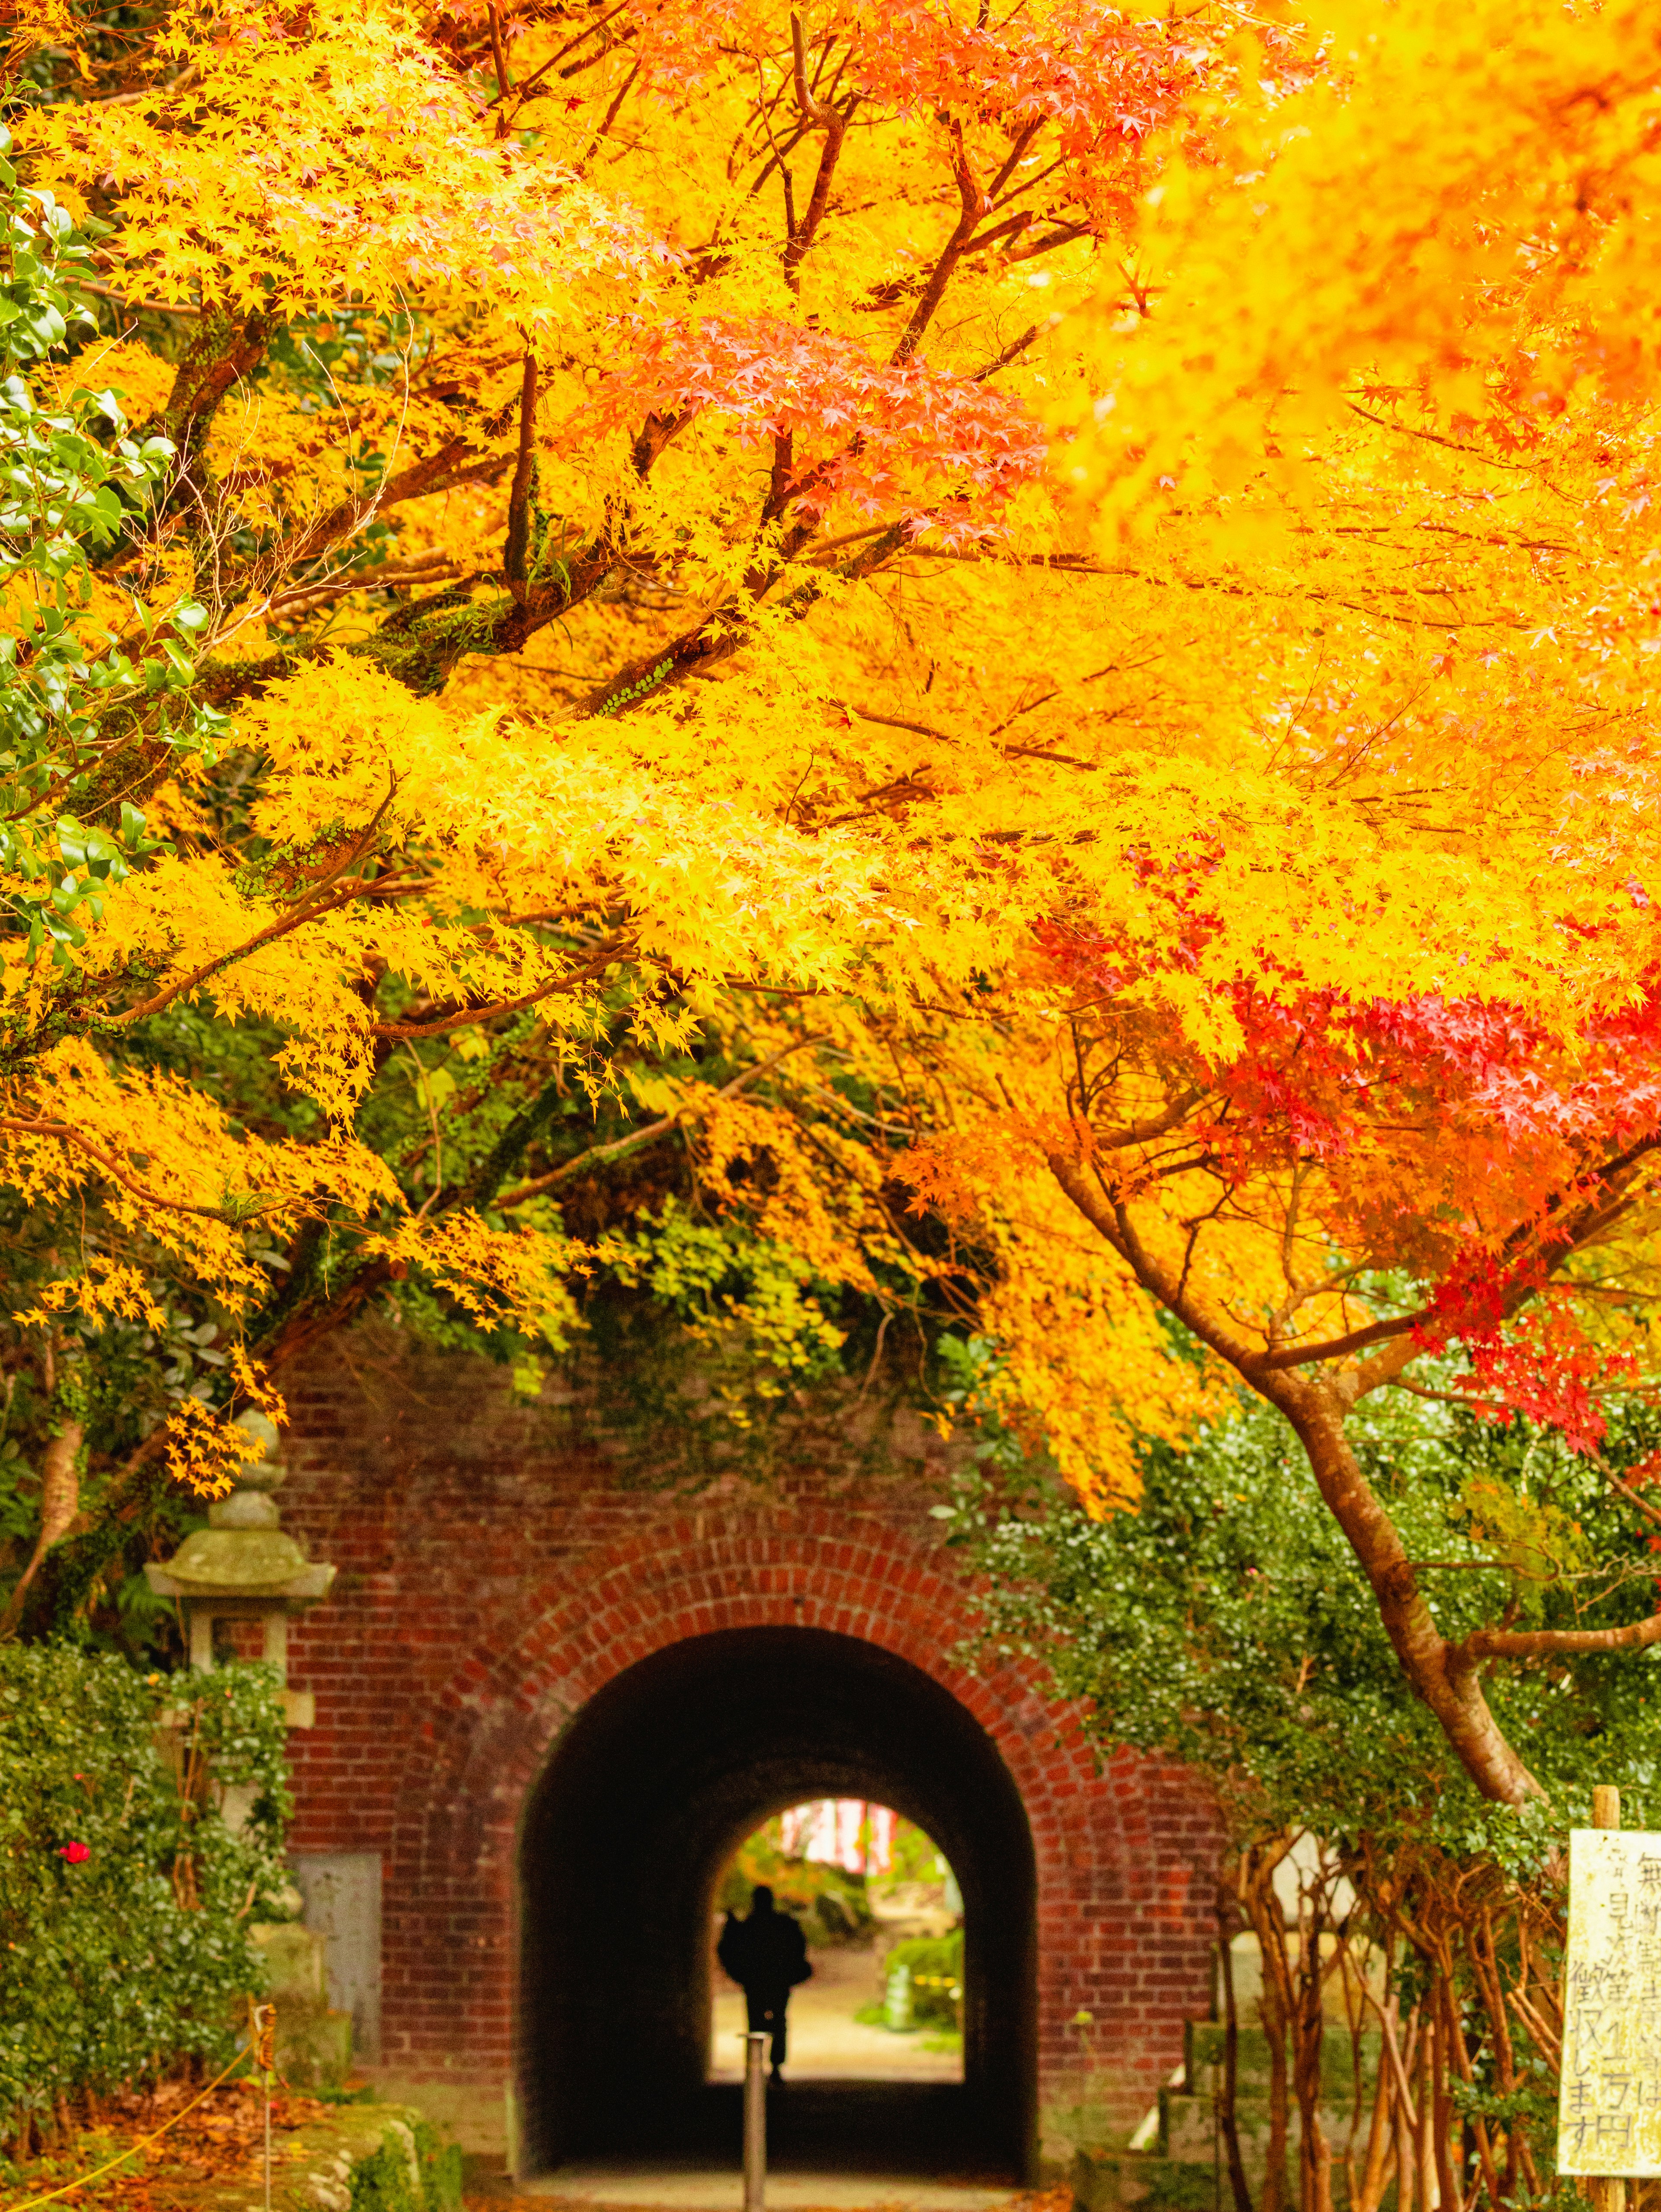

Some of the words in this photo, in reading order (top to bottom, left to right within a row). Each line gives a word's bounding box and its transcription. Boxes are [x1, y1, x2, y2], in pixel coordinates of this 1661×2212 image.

[1565, 1960, 1605, 2153] 徴収します
